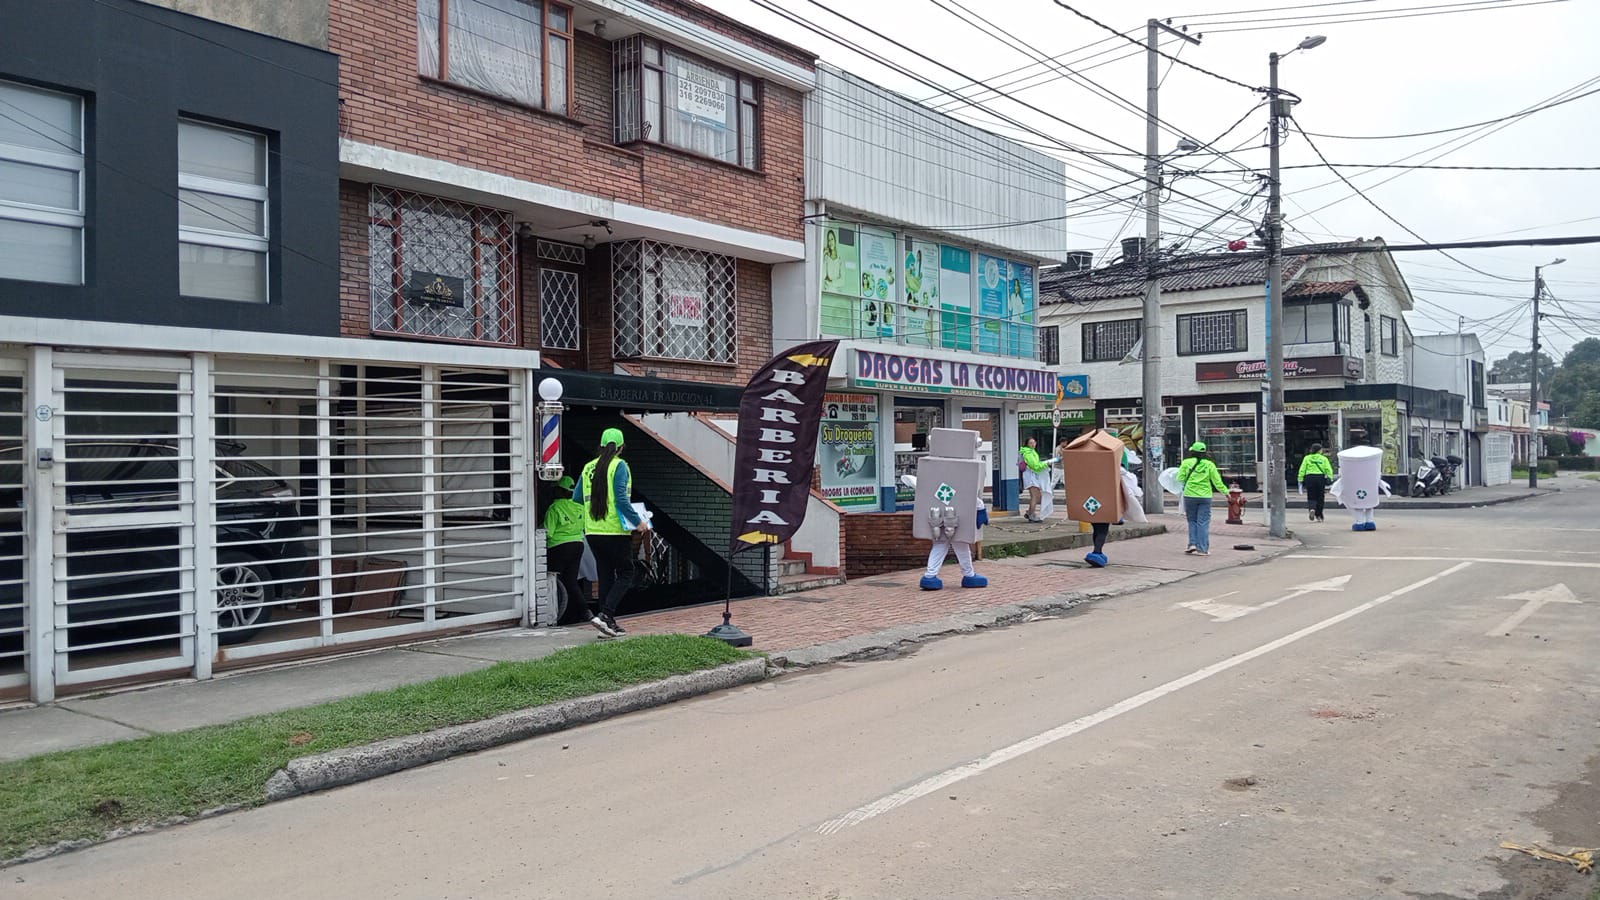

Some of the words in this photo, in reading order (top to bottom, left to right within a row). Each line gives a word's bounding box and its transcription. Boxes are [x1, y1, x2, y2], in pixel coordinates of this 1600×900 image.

[679, 81, 692, 92] 321
[858, 351, 942, 384] DROGAS
[950, 362, 969, 387] LA
[975, 365, 1055, 393] ECONOMIA
[600, 386, 649, 400] BARBERIA
[823, 425, 833, 441] Su
[746, 368, 806, 526] BARBERIA
[843, 487, 850, 496] LA
